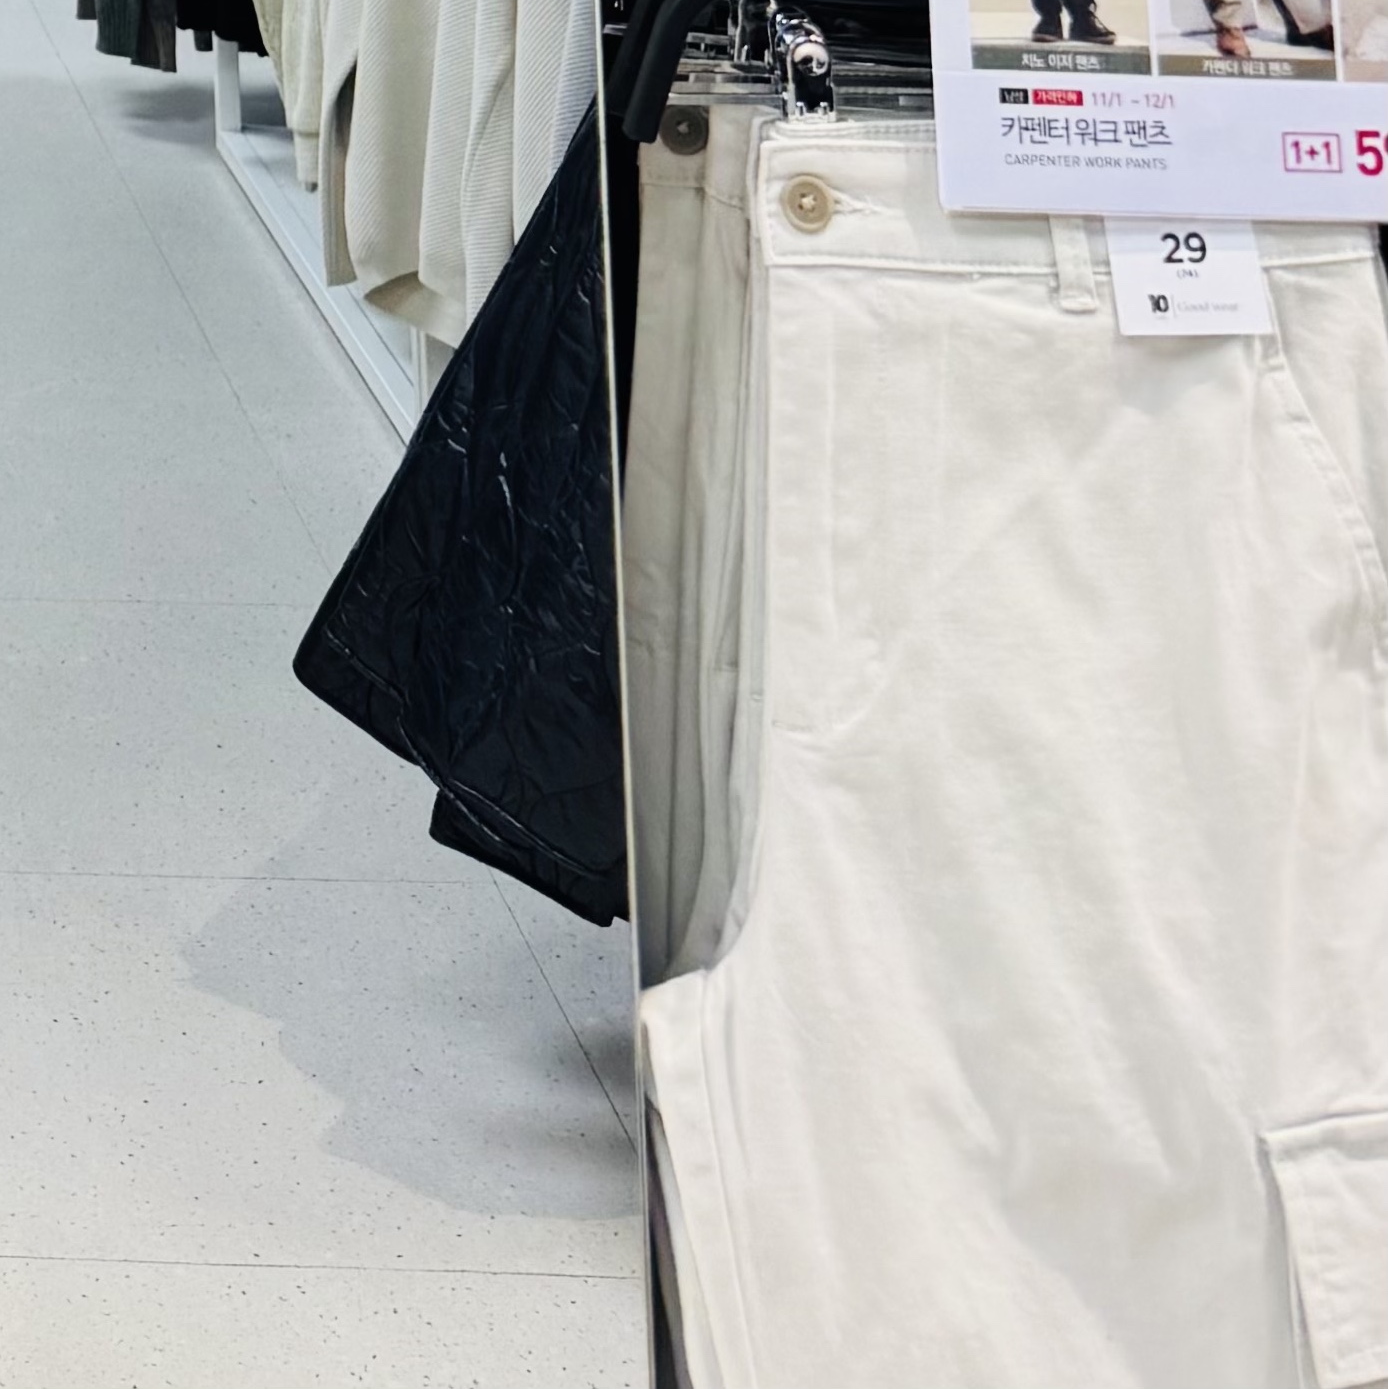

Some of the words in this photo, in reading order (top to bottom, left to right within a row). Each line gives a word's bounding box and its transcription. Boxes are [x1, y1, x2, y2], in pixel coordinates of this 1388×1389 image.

[1091, 92, 1122, 108] 11/1
[1144, 93, 1175, 108] 12/1
[1001, 115, 1071, 145] 카펜터
[1073, 118, 1122, 147] 워크
[1123, 119, 1173, 148] 팬츠
[1004, 153, 1081, 167] CARPENTER
[1084, 155, 1122, 168] WORK
[1125, 157, 1168, 171] PANTS
[1289, 140, 1333, 166] 1+1
[1354, 129, 1388, 177] 5
[1160, 231, 1207, 264] 29
